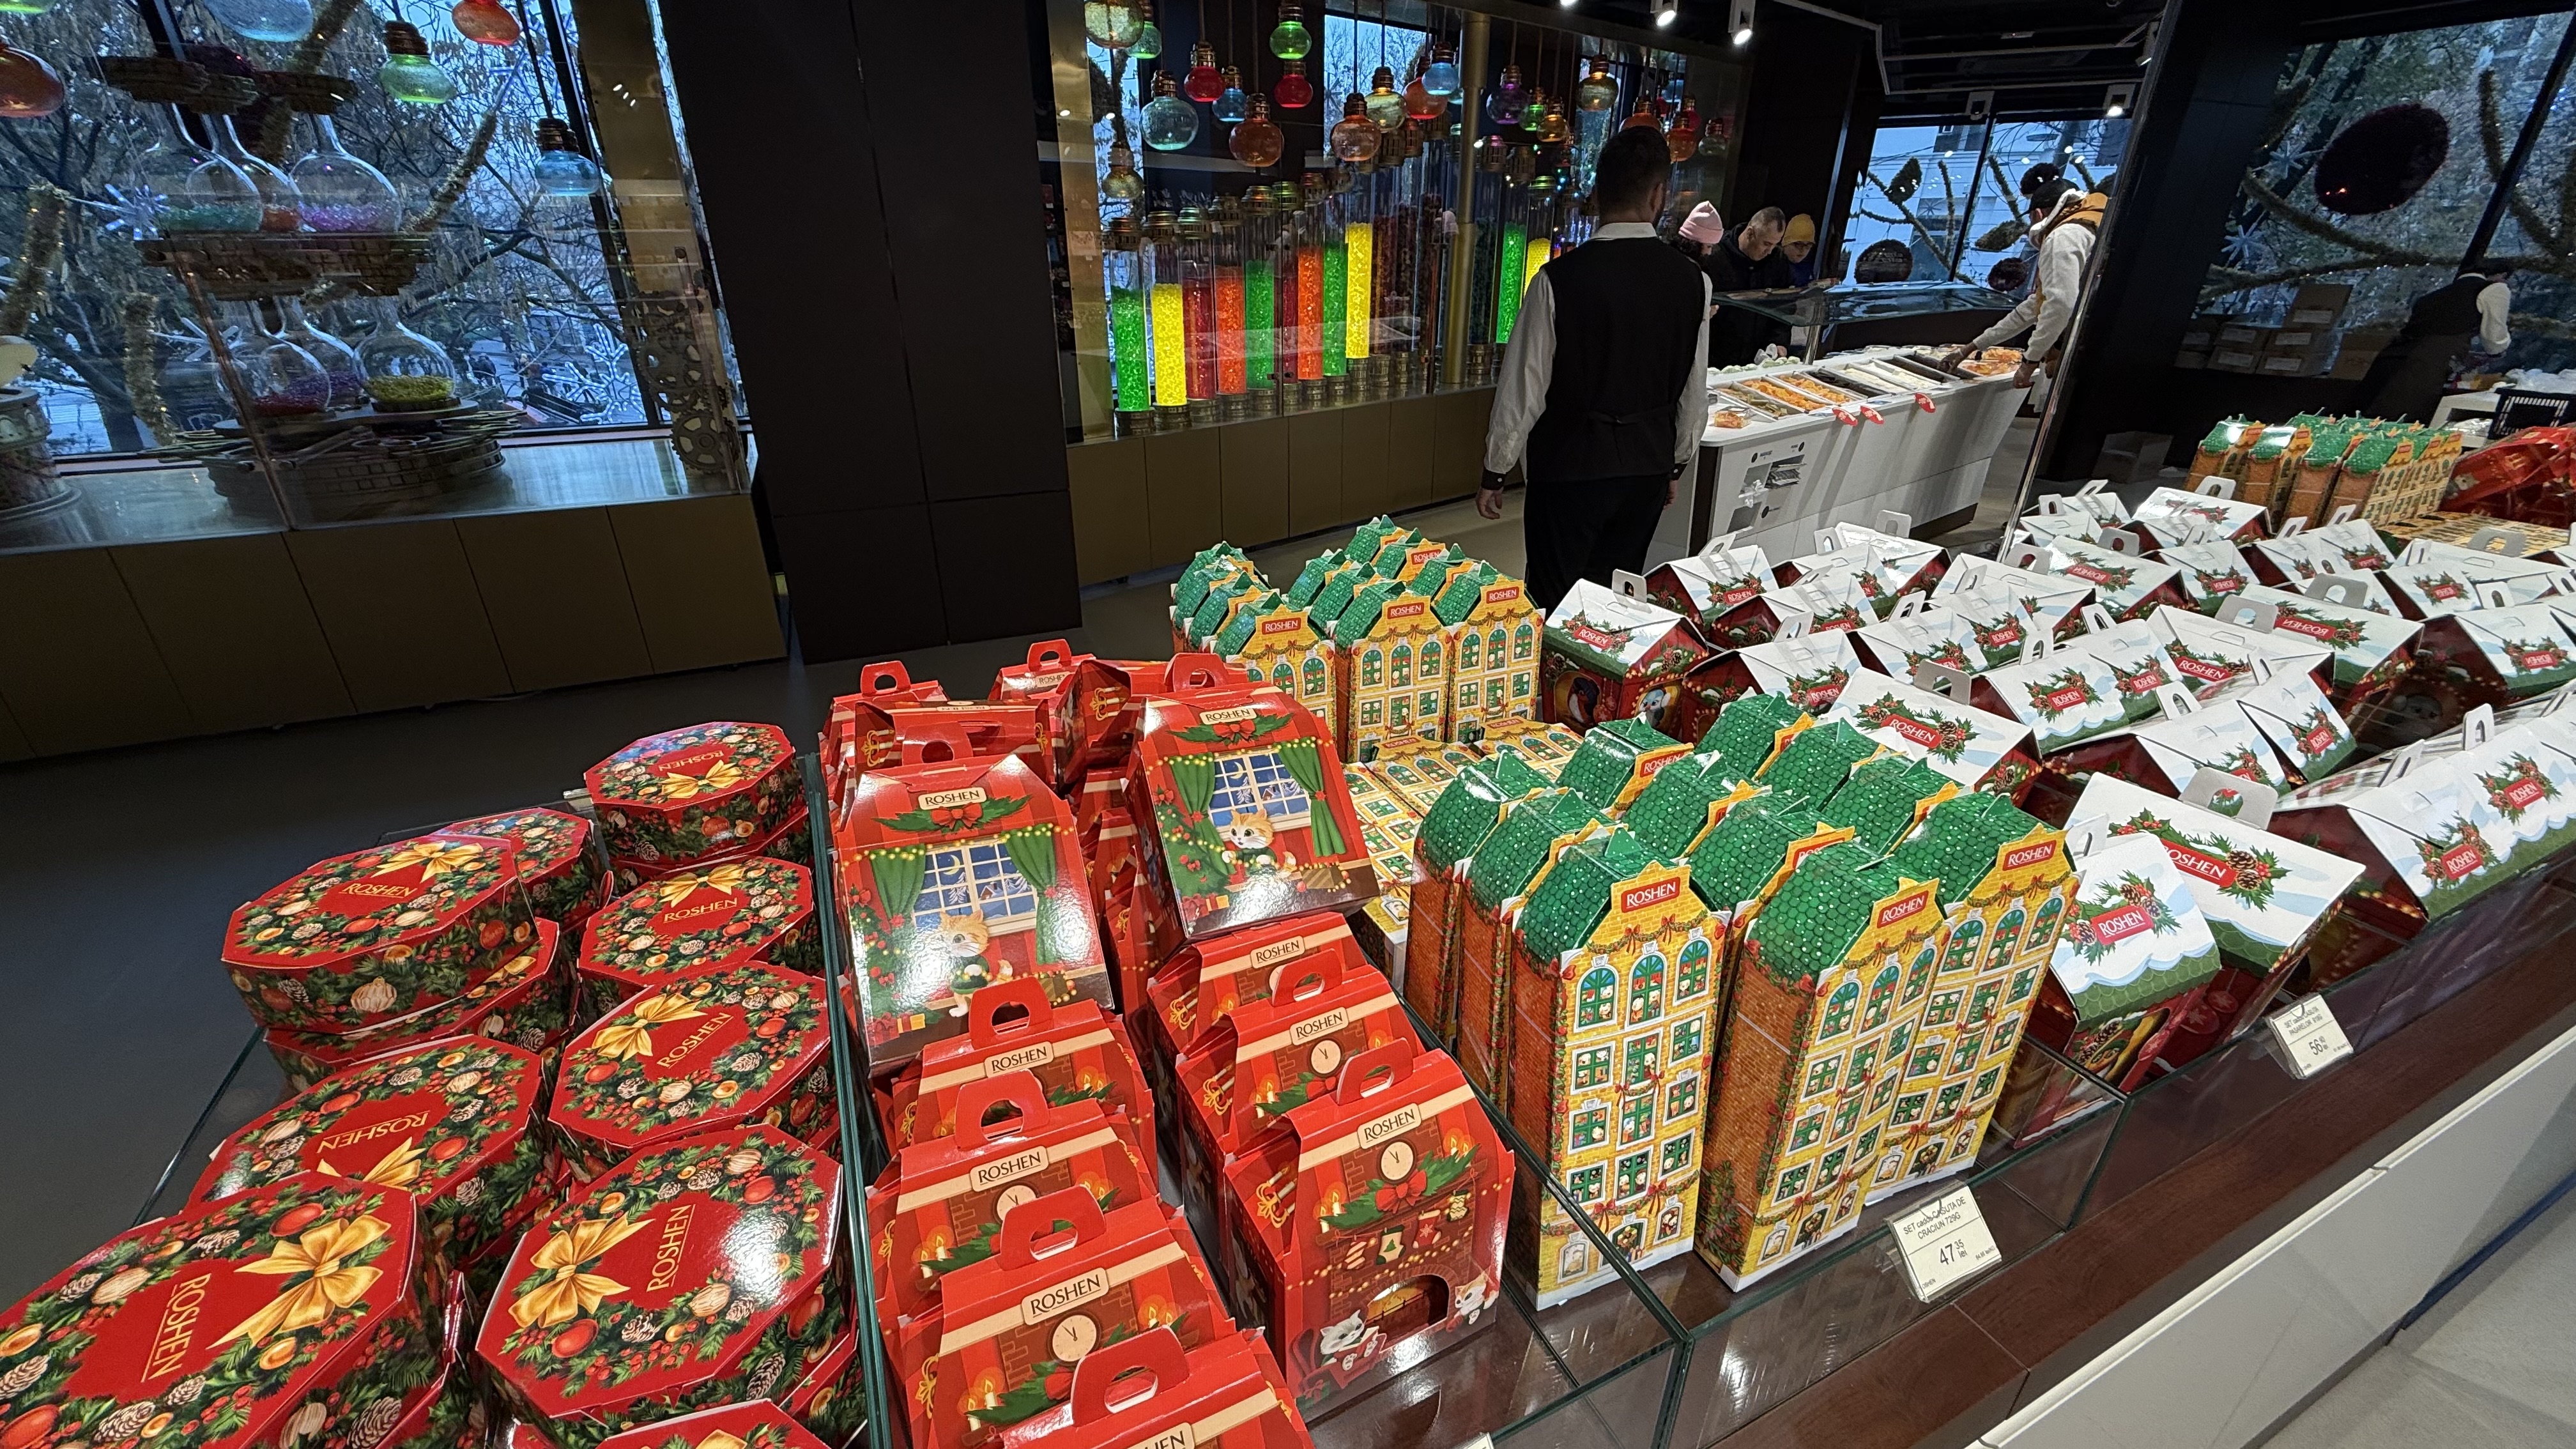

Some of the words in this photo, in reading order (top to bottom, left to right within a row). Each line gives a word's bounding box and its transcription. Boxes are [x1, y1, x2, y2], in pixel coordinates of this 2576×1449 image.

[1489, 588, 1517, 601] ROSHEN
[1390, 604, 1423, 617] ROSHEN
[1264, 619, 1299, 632] ROSHEN
[1579, 629, 1609, 645] ROSHEN
[2179, 659, 2225, 680] ROSHEN
[1811, 688, 1840, 702] ROSHEN
[2052, 691, 2080, 707] ROSHEN
[1205, 708, 1251, 723] ROSHEN
[1889, 719, 1936, 742] ROSHEN
[658, 750, 724, 772] ROSHEN
[924, 790, 981, 806] ROSHEN
[2509, 781, 2538, 802] ROSHEN
[2008, 845, 2053, 866] ROSHEN
[2446, 850, 2477, 873] ROSHEN
[339, 883, 417, 898] ROSHEN
[1626, 881, 1677, 908] ROSHEN
[663, 897, 738, 923] ROSHEN
[1882, 895, 1926, 922] ROSHEN
[2098, 910, 2145, 937] ROSHEN
[1256, 940, 1300, 962] ROSHEN
[1296, 1012, 1343, 1039] ROSHEN
[657, 1012, 733, 1068] ROSHEN
[2308, 1038, 2324, 1055] 56
[991, 1045, 1049, 1074] ROSHEN
[318, 1110, 431, 1153] ROSHEN
[1362, 1108, 1416, 1142] ROSHEN
[977, 1150, 1043, 1184] ROSHEN
[1903, 1222, 1916, 1235] SET
[1956, 1196, 1966, 1208] DE
[1917, 1220, 1946, 1240] CRACIUN
[647, 1204, 696, 1293] ROSHEN
[1939, 1243, 1955, 1265] 47
[1954, 1239, 1965, 1250] 35
[1958, 1249, 1968, 1259] lei
[1029, 1274, 1101, 1315] ROSHEN
[141, 1273, 212, 1383] ROSHEN
